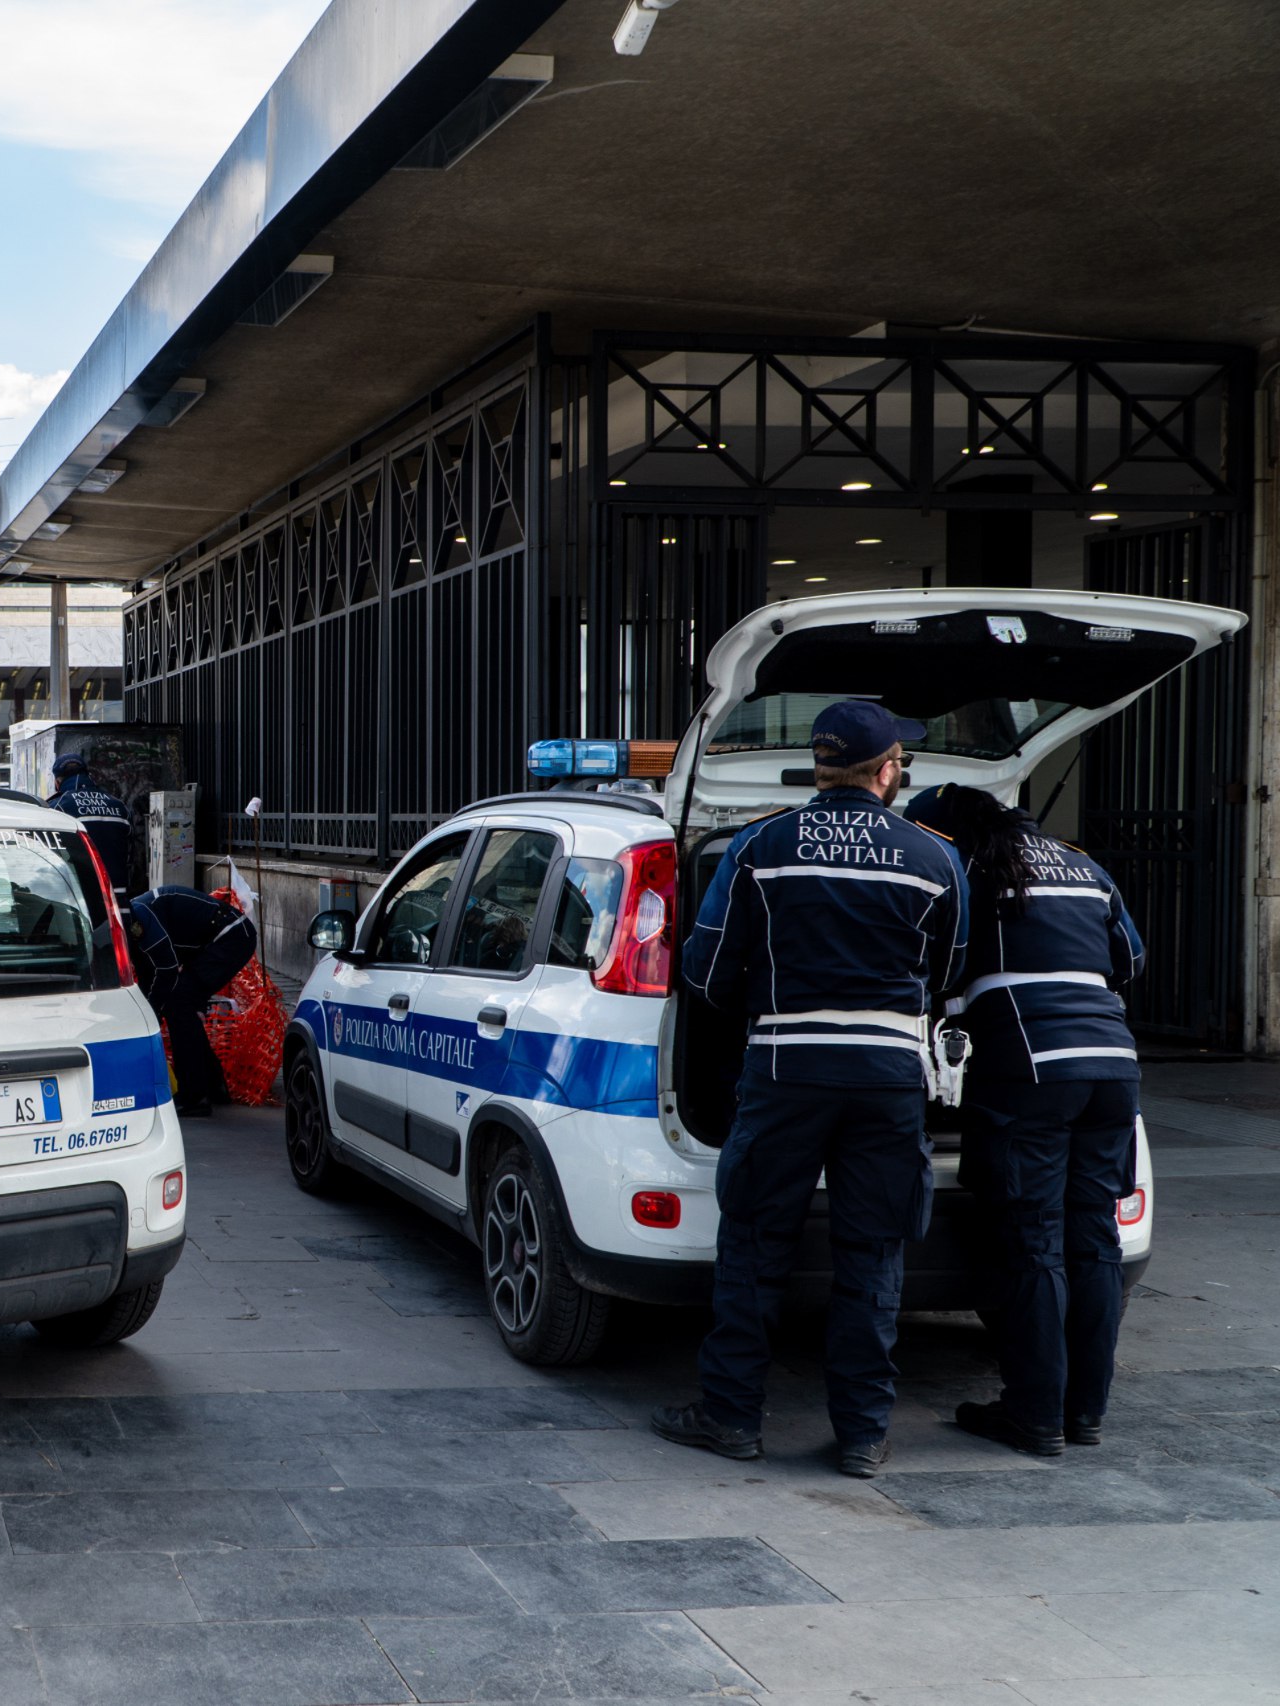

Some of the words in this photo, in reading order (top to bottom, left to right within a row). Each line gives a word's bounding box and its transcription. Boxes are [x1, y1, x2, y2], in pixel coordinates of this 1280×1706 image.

[72, 791, 111, 801] POLIZIA
[75, 799, 108, 807] ROMA
[78, 806, 122, 816] CAPITALE
[799, 811, 891, 830] POLIZIA
[798, 826, 874, 844] ROMA
[797, 843, 905, 867] CAPITALE
[1020, 848, 1067, 866] OMA
[345, 1018, 380, 1049] POLIZIA
[382, 1023, 416, 1057] ROMA
[419, 1030, 477, 1069] CAPITALE
[15, 1097, 36, 1123] AS
[33, 1136, 63, 1154] TEL.
[68, 1125, 128, 1150] 06.67691
